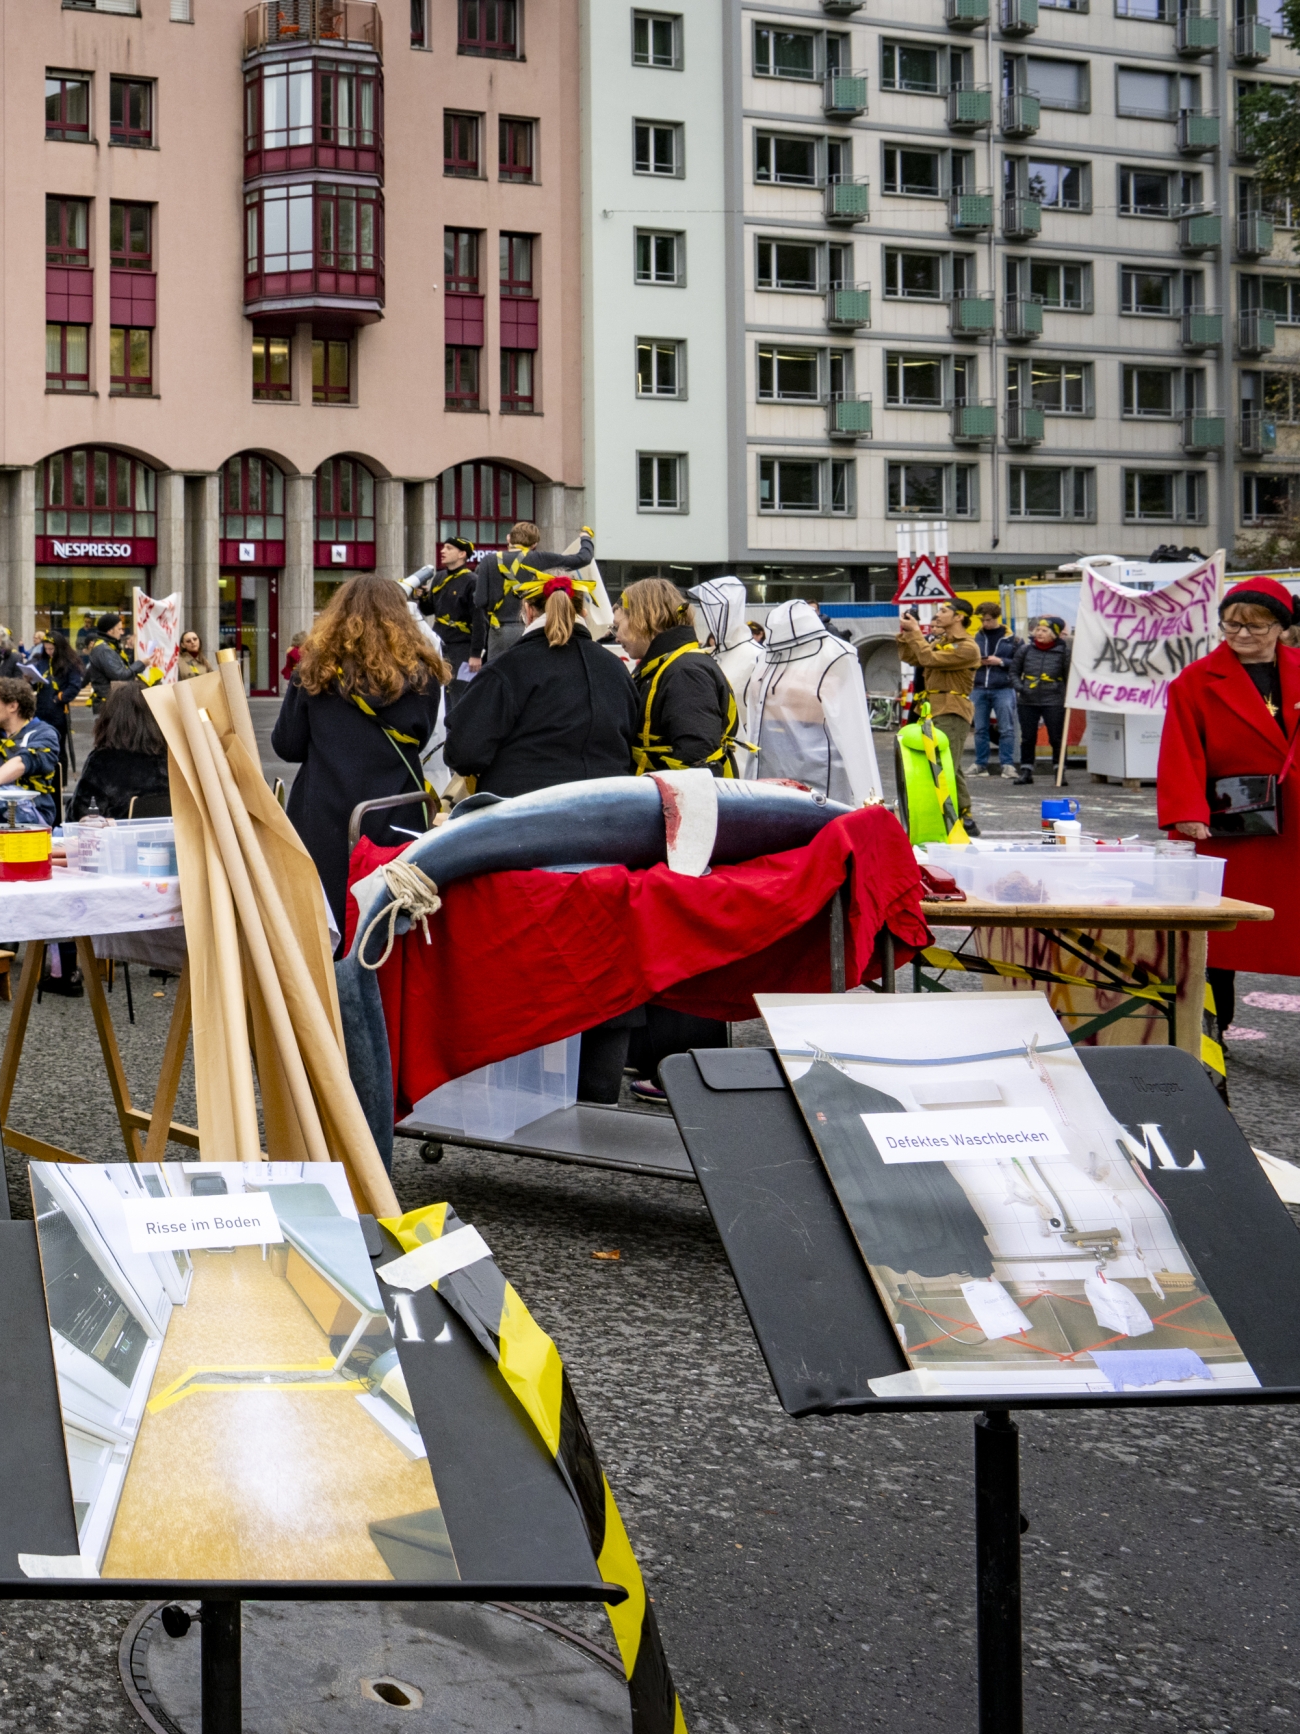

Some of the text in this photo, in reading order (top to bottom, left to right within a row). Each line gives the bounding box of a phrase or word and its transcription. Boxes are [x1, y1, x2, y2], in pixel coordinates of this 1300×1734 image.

[51, 540, 132, 558] NESPRESSO
[1093, 637, 1164, 676] ABER
[1075, 679, 1114, 701] AUF
[1114, 685, 1152, 705] DEM
[886, 1131, 1049, 1149] Defektes Waschbecken
[146, 1216, 261, 1234] Risse im Boden
